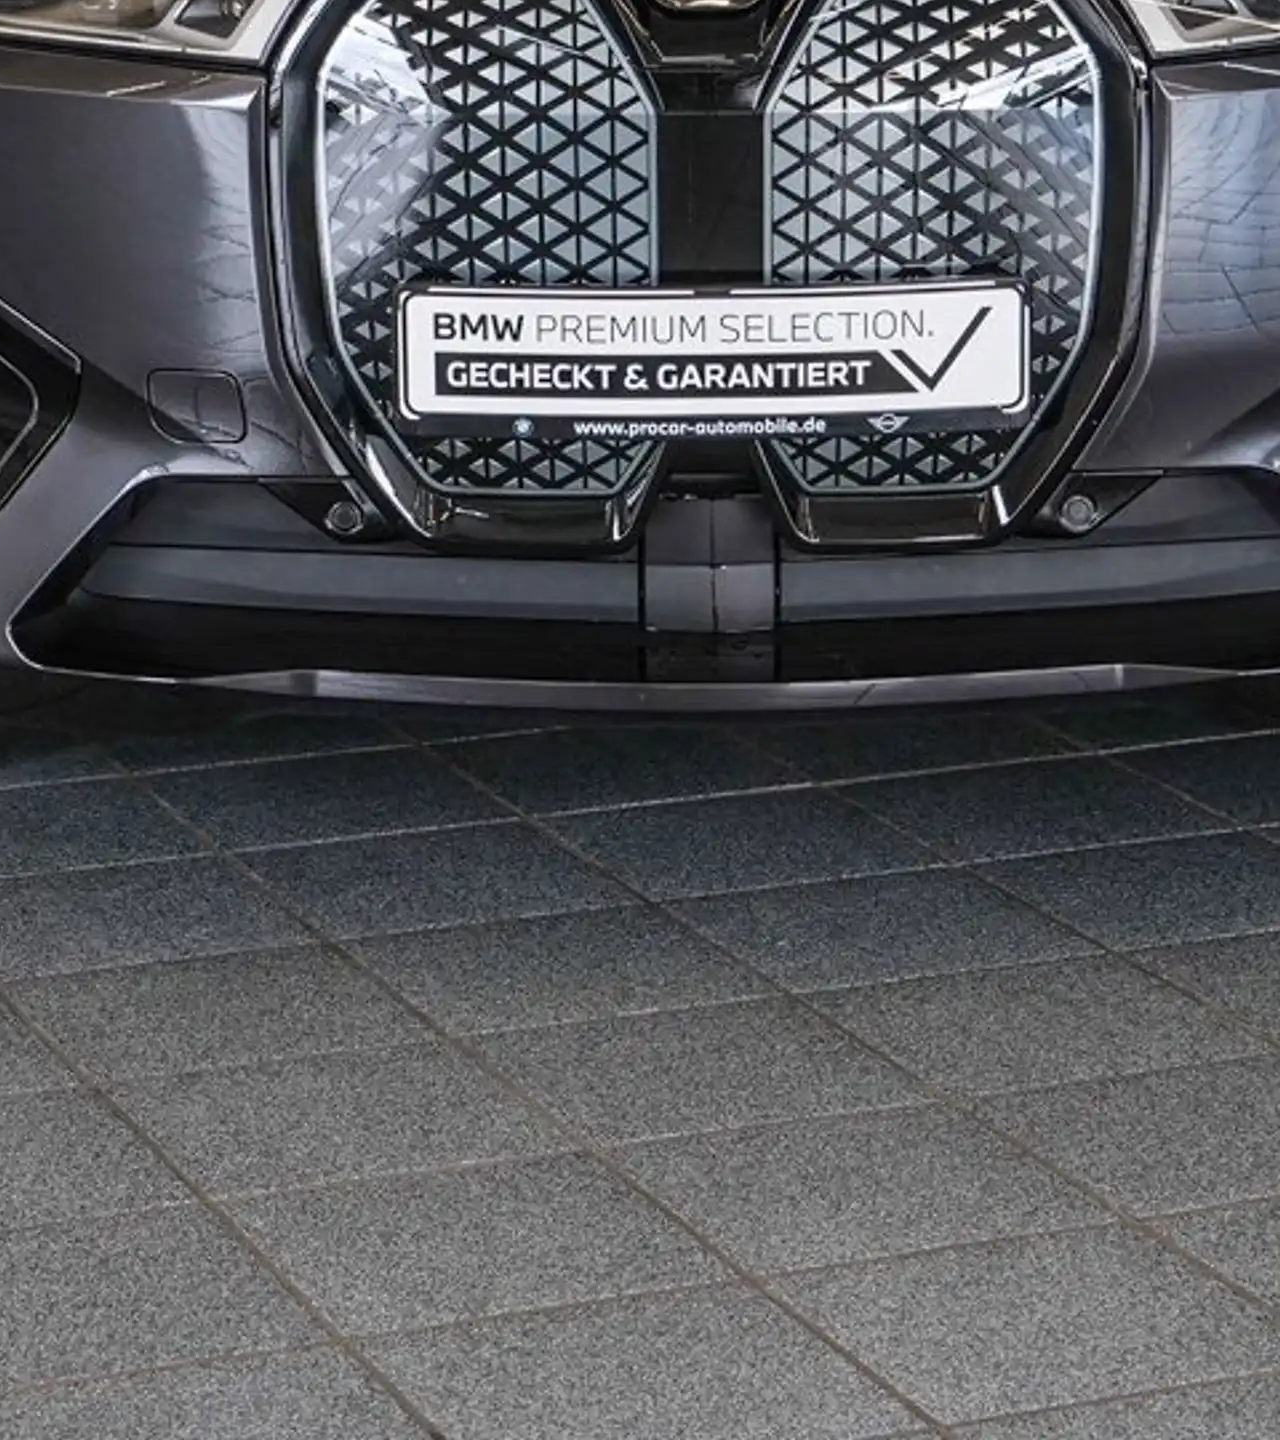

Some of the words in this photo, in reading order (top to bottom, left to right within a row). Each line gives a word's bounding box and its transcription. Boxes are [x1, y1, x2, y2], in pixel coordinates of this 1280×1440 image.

[433, 312, 524, 341] BMW
[535, 314, 706, 344] PREMIUM
[719, 309, 934, 343] SELECTION.
[447, 361, 617, 389] GECHECKT
[623, 363, 650, 390] &
[656, 360, 872, 390] GARANTIERT
[574, 416, 826, 438] www.procar-automobile.de
